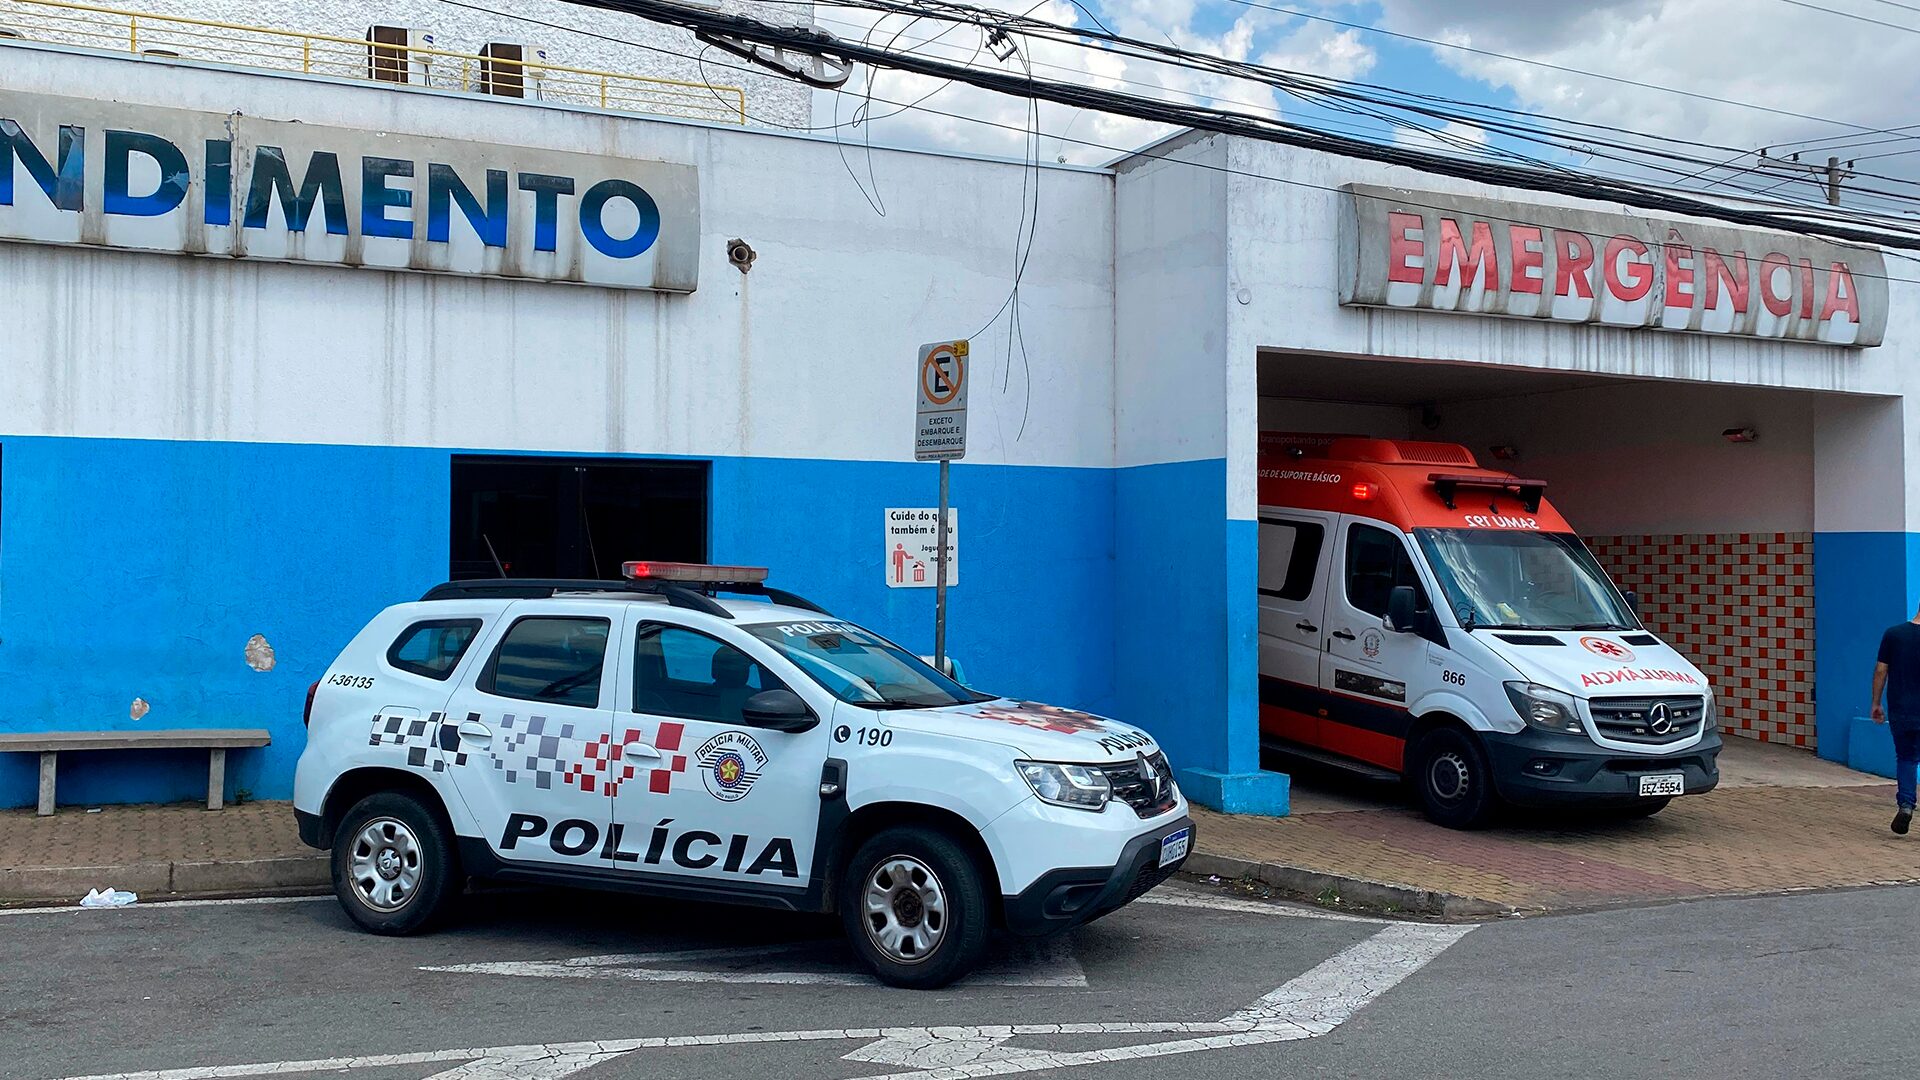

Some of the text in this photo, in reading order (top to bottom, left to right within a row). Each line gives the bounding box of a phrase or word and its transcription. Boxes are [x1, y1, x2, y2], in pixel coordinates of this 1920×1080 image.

[1387, 210, 1860, 324] EMERGÊNCIA
[929, 416, 953, 425] EXCETO
[921, 426, 960, 436] EMBARQUE E
[917, 437, 963, 447] DESEMBARQUE
[1270, 469, 1280, 478] DE
[1280, 469, 1313, 481] SUPORTE
[1312, 471, 1341, 484] BÁSICO
[890, 510, 915, 521] Cuide
[918, 510, 930, 521] do
[891, 524, 928, 534] também
[930, 525, 936, 534] é
[776, 620, 860, 637] POLÍCIA
[327, 673, 375, 689] I-36135
[1442, 669, 1466, 686] 866
[856, 726, 893, 747] 190
[699, 734, 764, 764] POLÍCIA MILITAR
[1641, 781, 1682, 795] EEZ-5554
[499, 813, 800, 879] POLÍCIA
